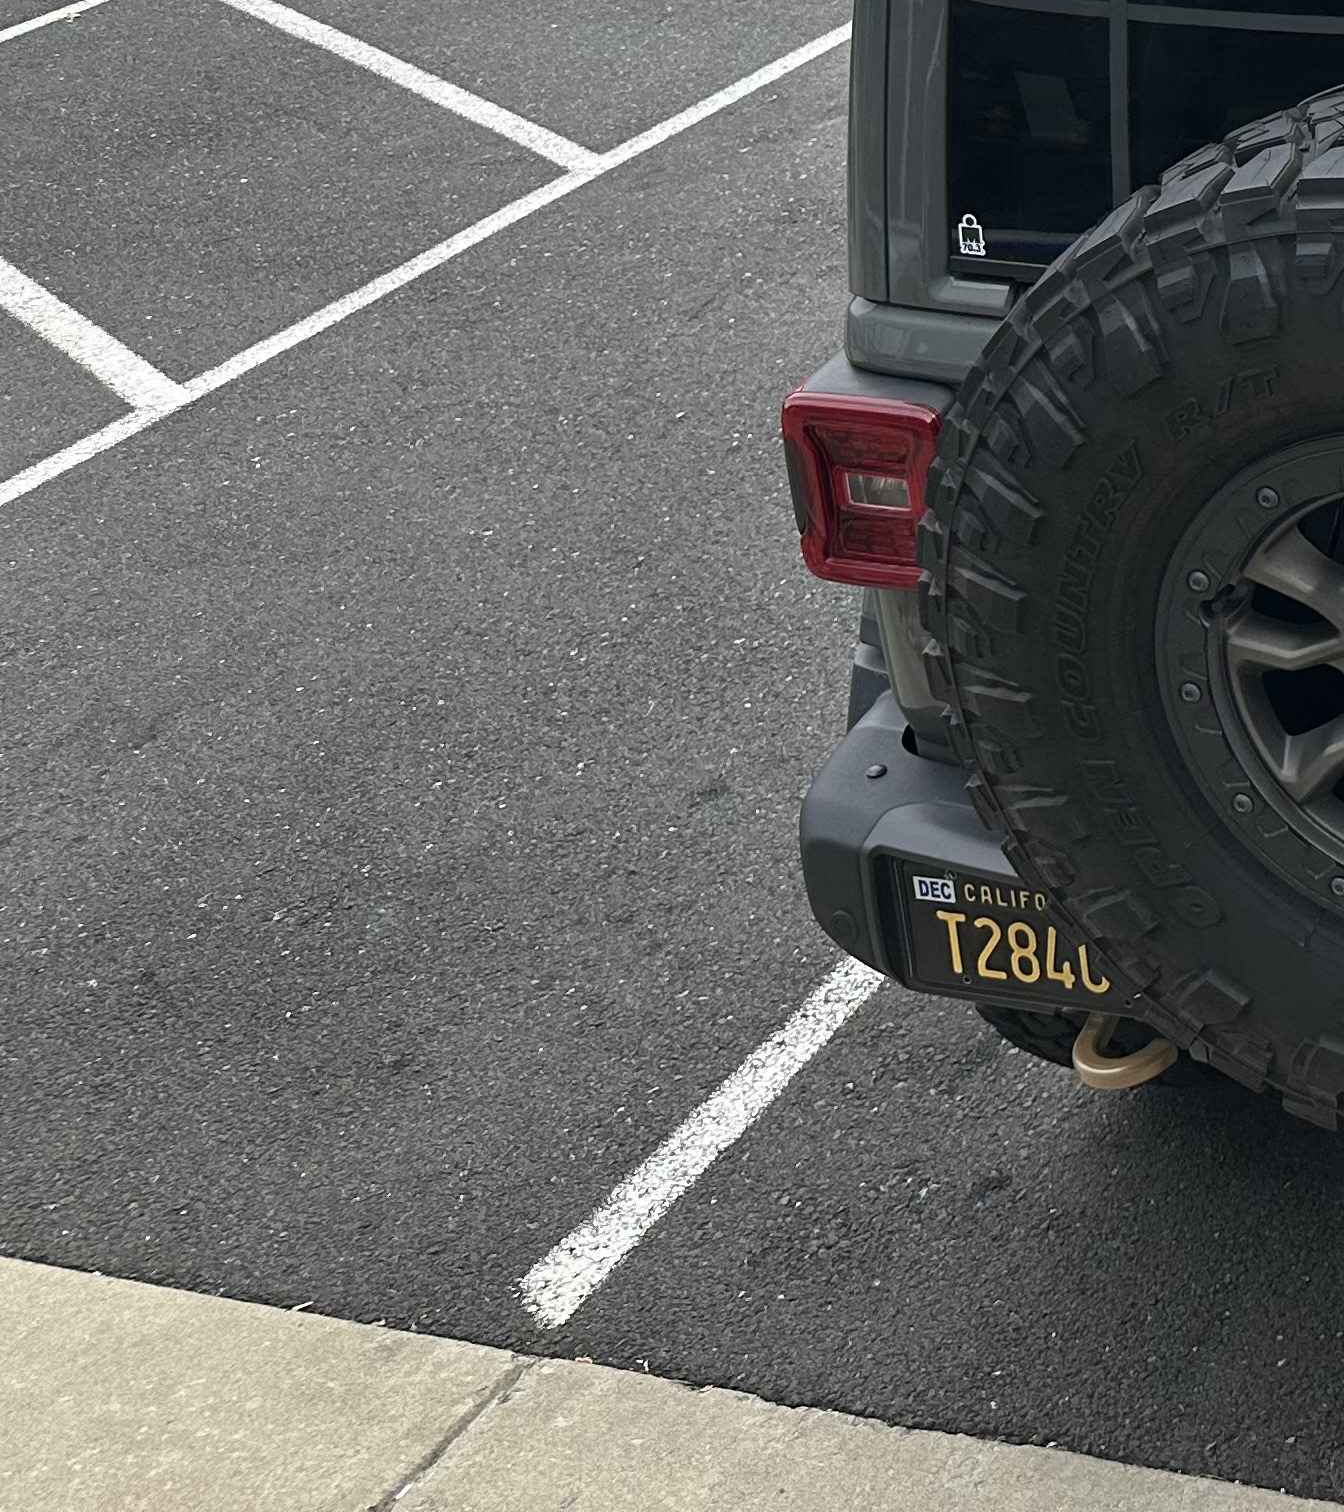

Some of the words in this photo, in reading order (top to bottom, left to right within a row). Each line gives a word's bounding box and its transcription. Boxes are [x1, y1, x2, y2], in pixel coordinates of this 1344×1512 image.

[1161, 364, 1279, 442] R/T
[1055, 439, 1146, 742] COUNTRY
[918, 879, 952, 900] DEC
[1079, 760, 1221, 927] OPEN
